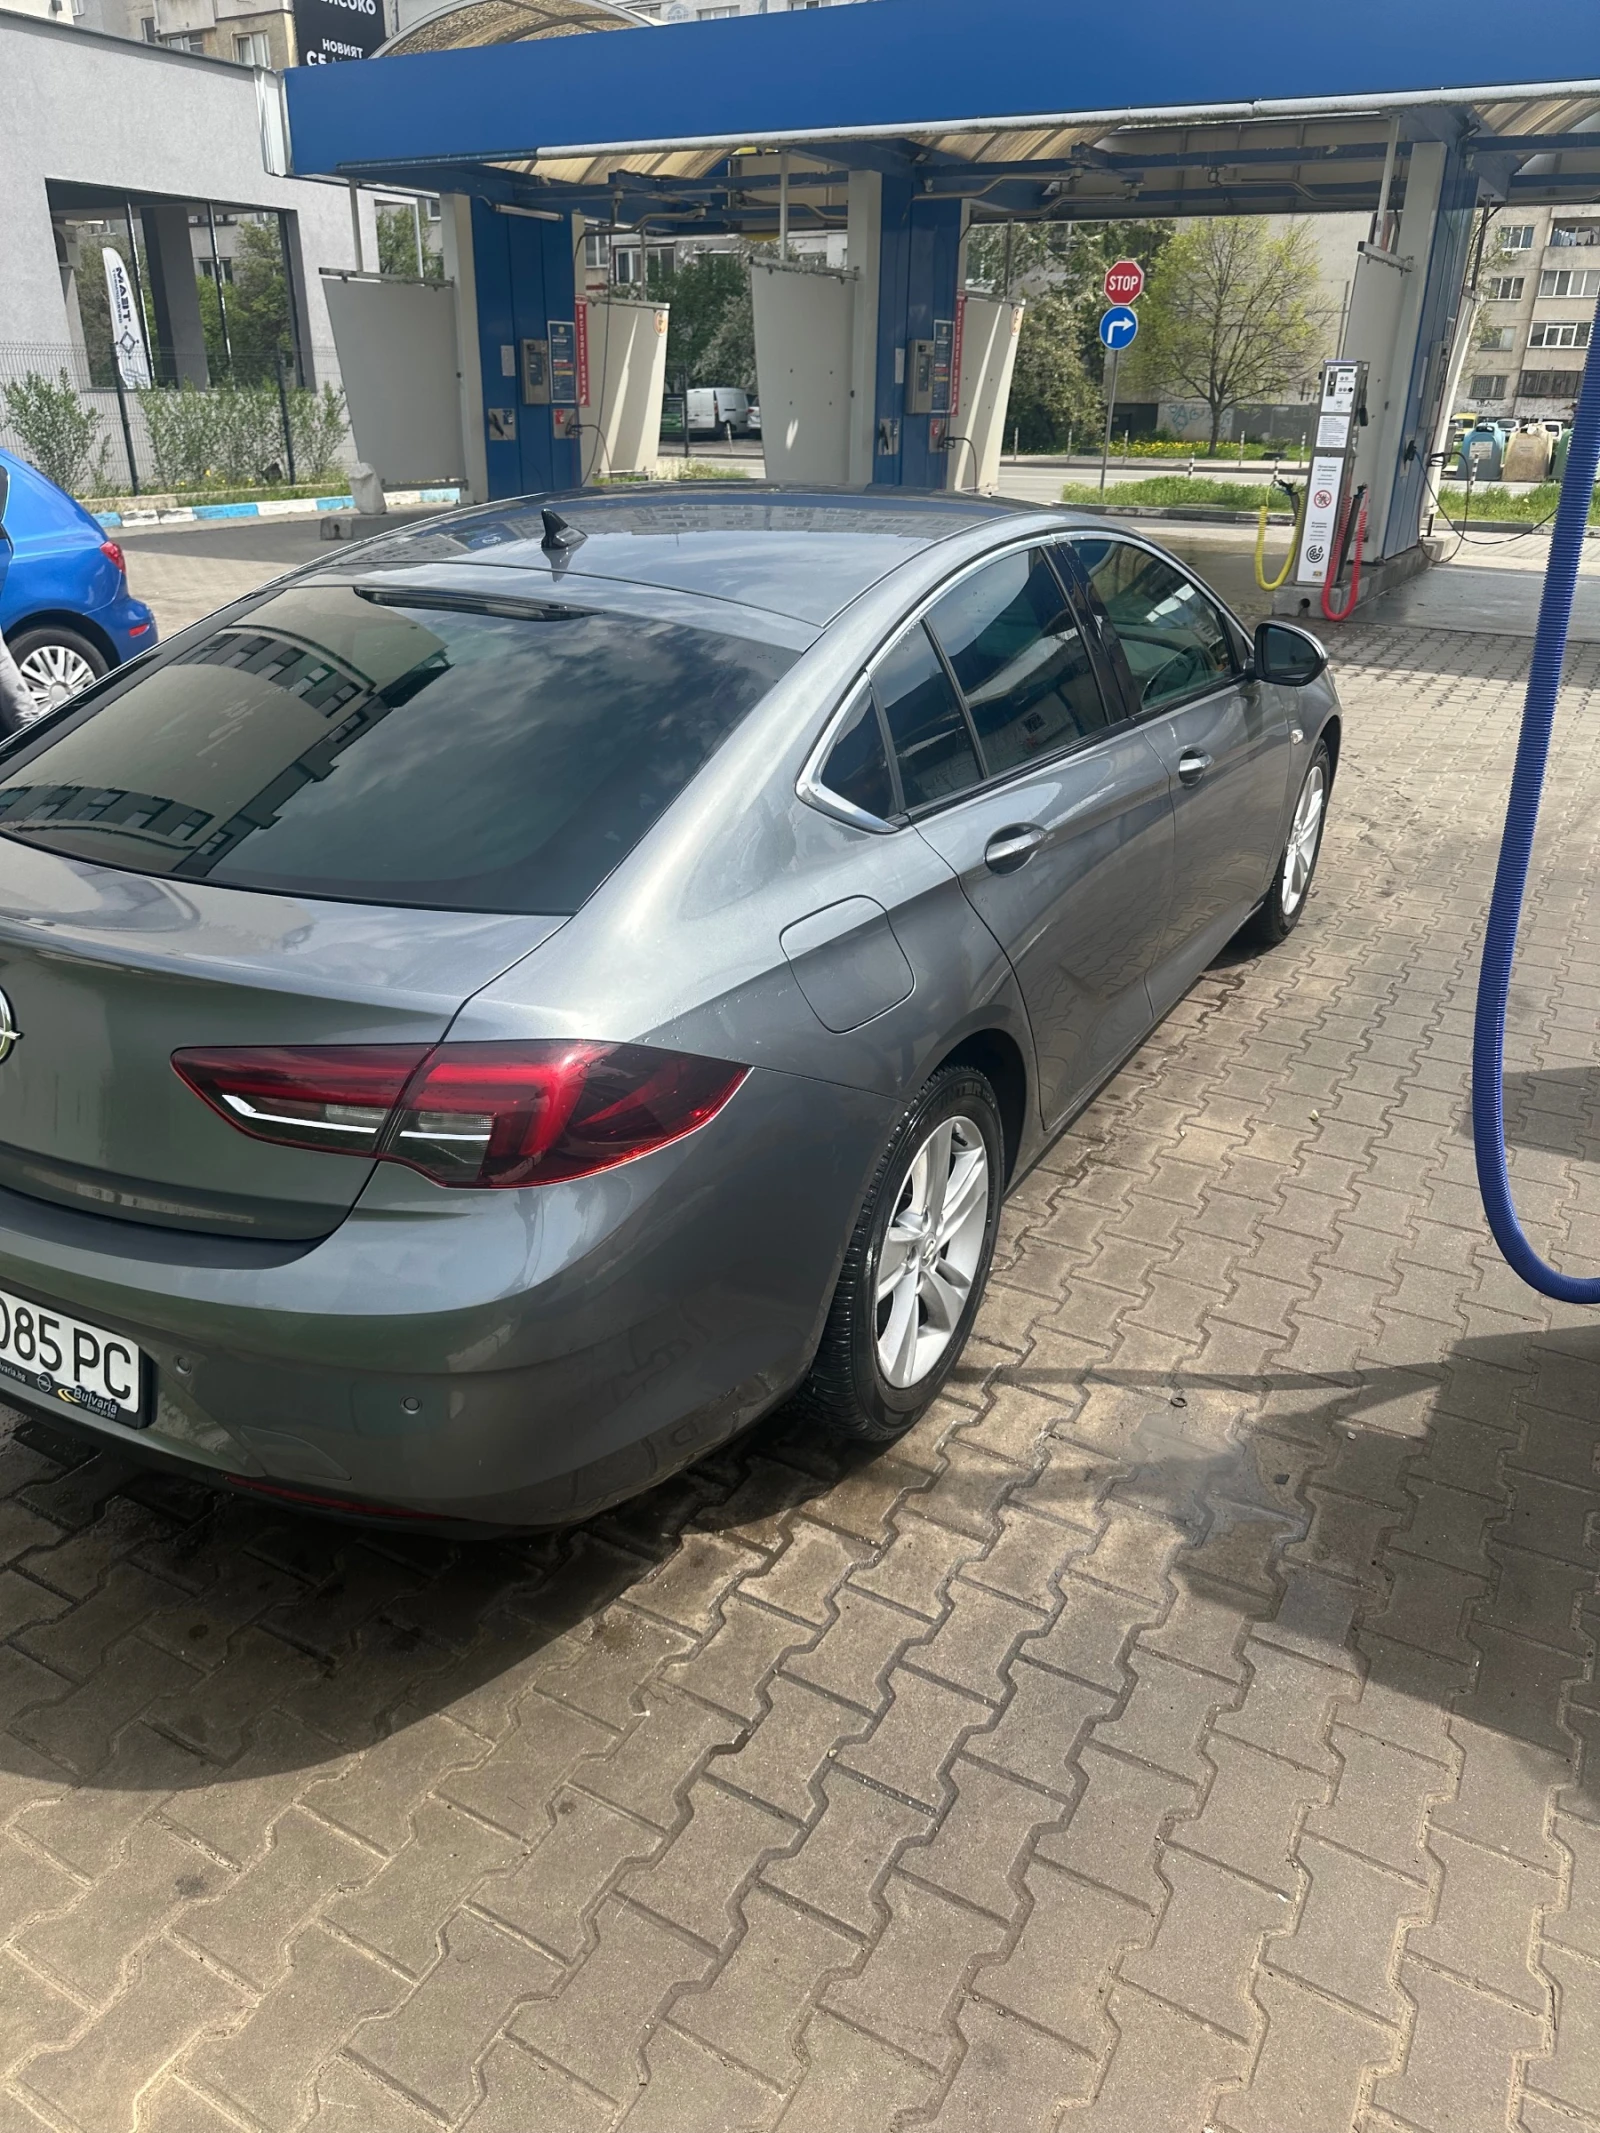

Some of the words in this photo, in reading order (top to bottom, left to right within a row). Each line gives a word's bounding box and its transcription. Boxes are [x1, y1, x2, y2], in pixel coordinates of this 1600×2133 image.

[322, 38, 364, 59] НОВИЯТ
[1108, 275, 1139, 292] STOP
[73, 1327, 131, 1400] PC
[74, 1387, 118, 1415] Bulvaria
